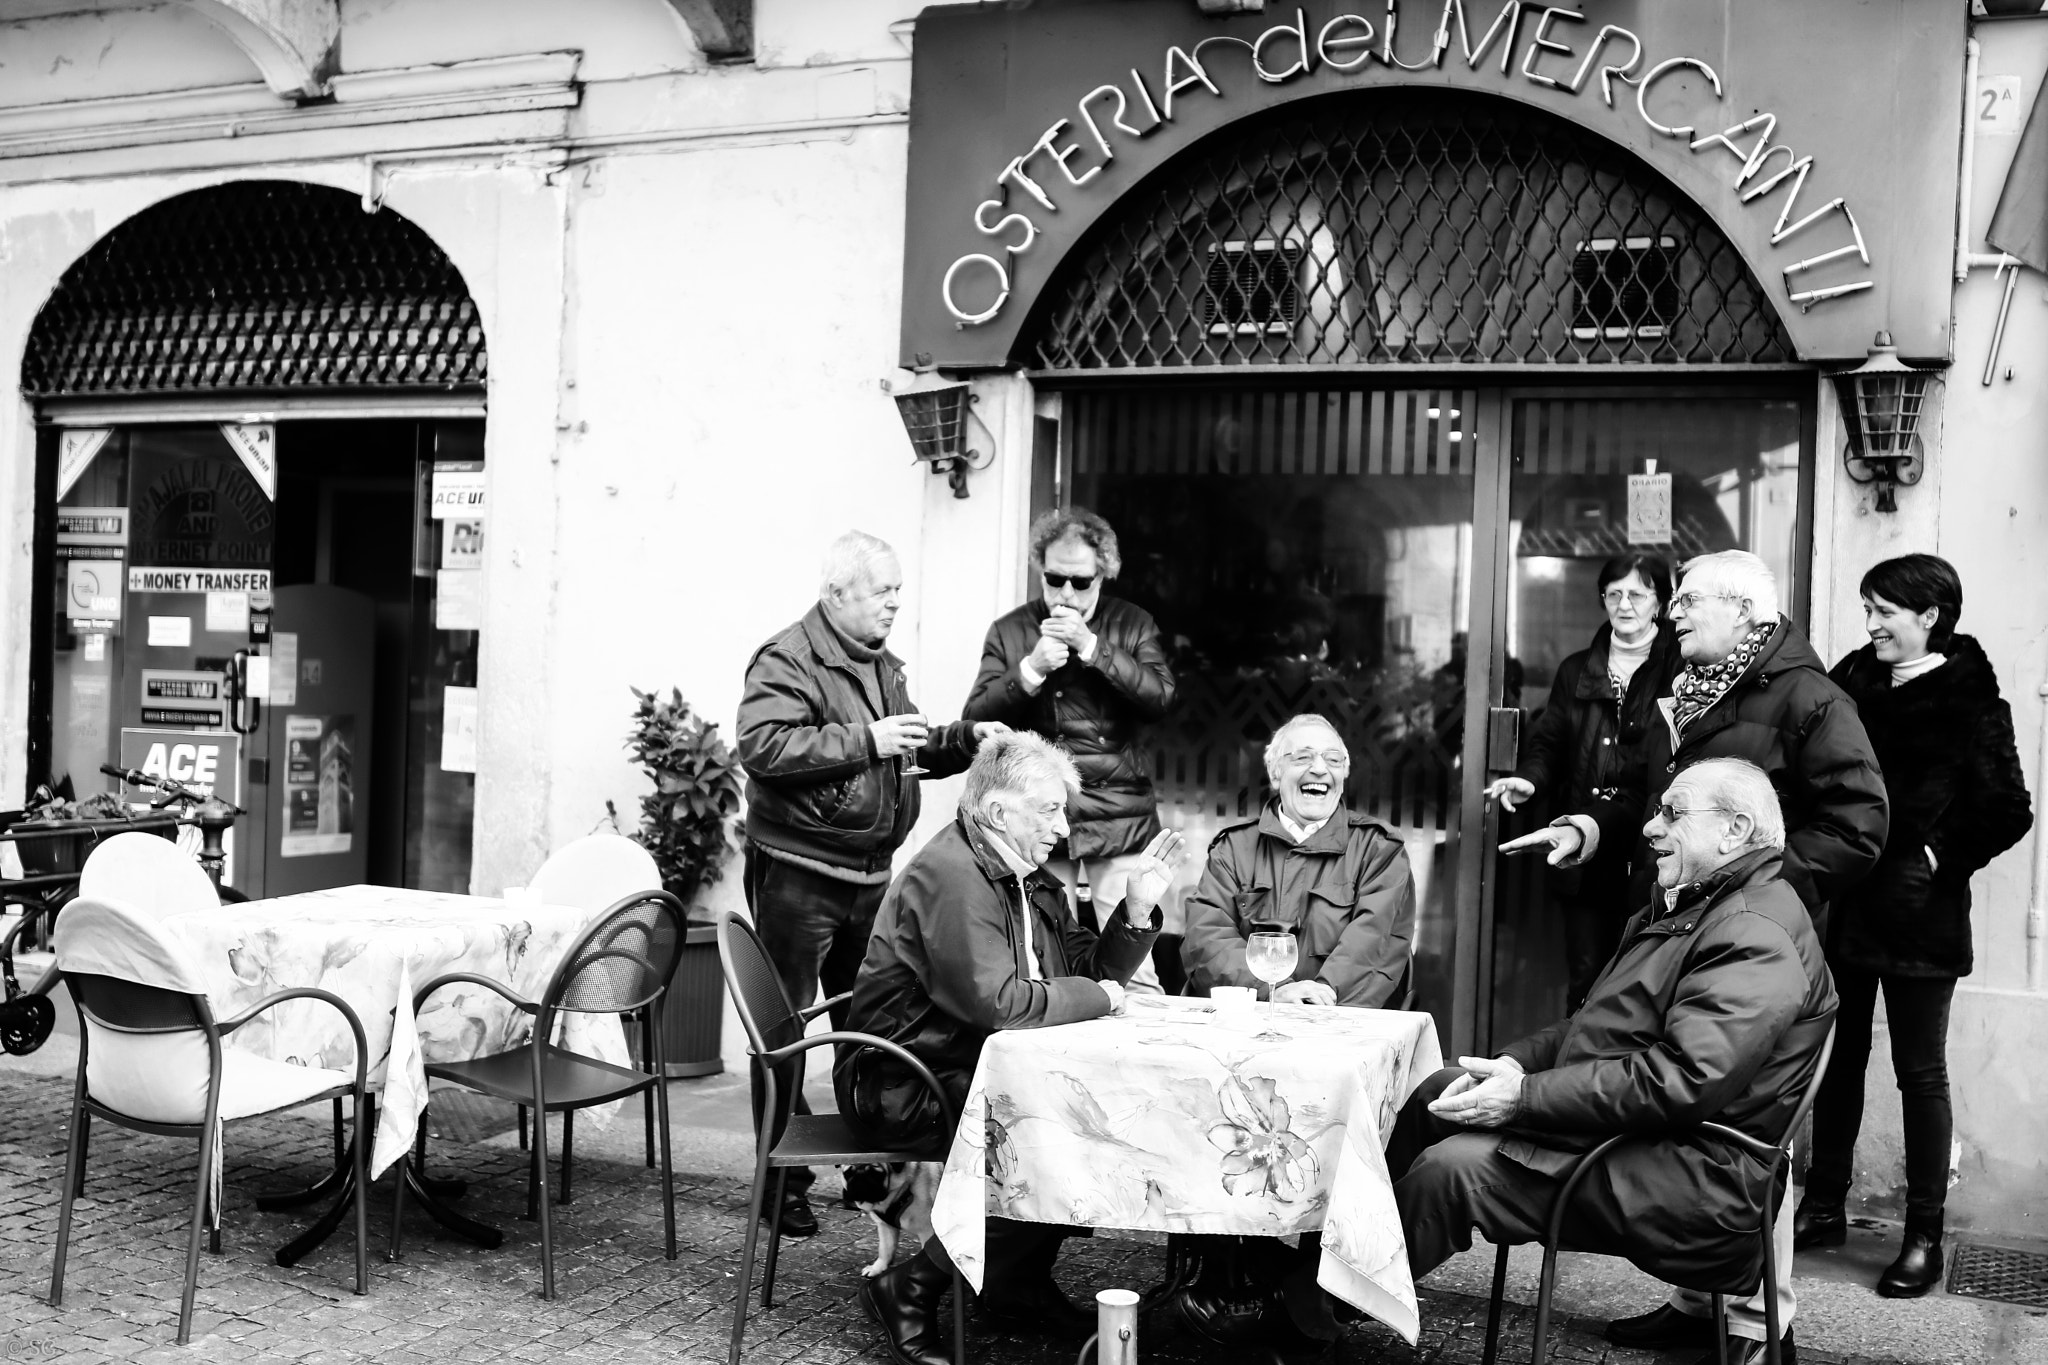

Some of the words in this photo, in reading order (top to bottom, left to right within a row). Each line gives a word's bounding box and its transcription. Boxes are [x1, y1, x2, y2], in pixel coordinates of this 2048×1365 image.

[1980, 88, 2013, 121] 2A
[943, 46, 1220, 324] OSTERIA
[1434, 0, 1875, 302] MERCANTI
[1631, 478, 1668, 487] ORARIO
[434, 491, 466, 505] ACE
[98, 517, 119, 533] WU
[177, 516, 222, 534] AND
[131, 541, 212, 562] INTERNET
[218, 541, 270, 562] POINT
[143, 572, 192, 589] MONEY
[196, 573, 268, 591] TRANSFER
[90, 596, 117, 612] UNO
[149, 681, 187, 690] WESTERN
[161, 687, 187, 697] UNION
[191, 681, 214, 698] WU
[141, 742, 219, 783] ACE
